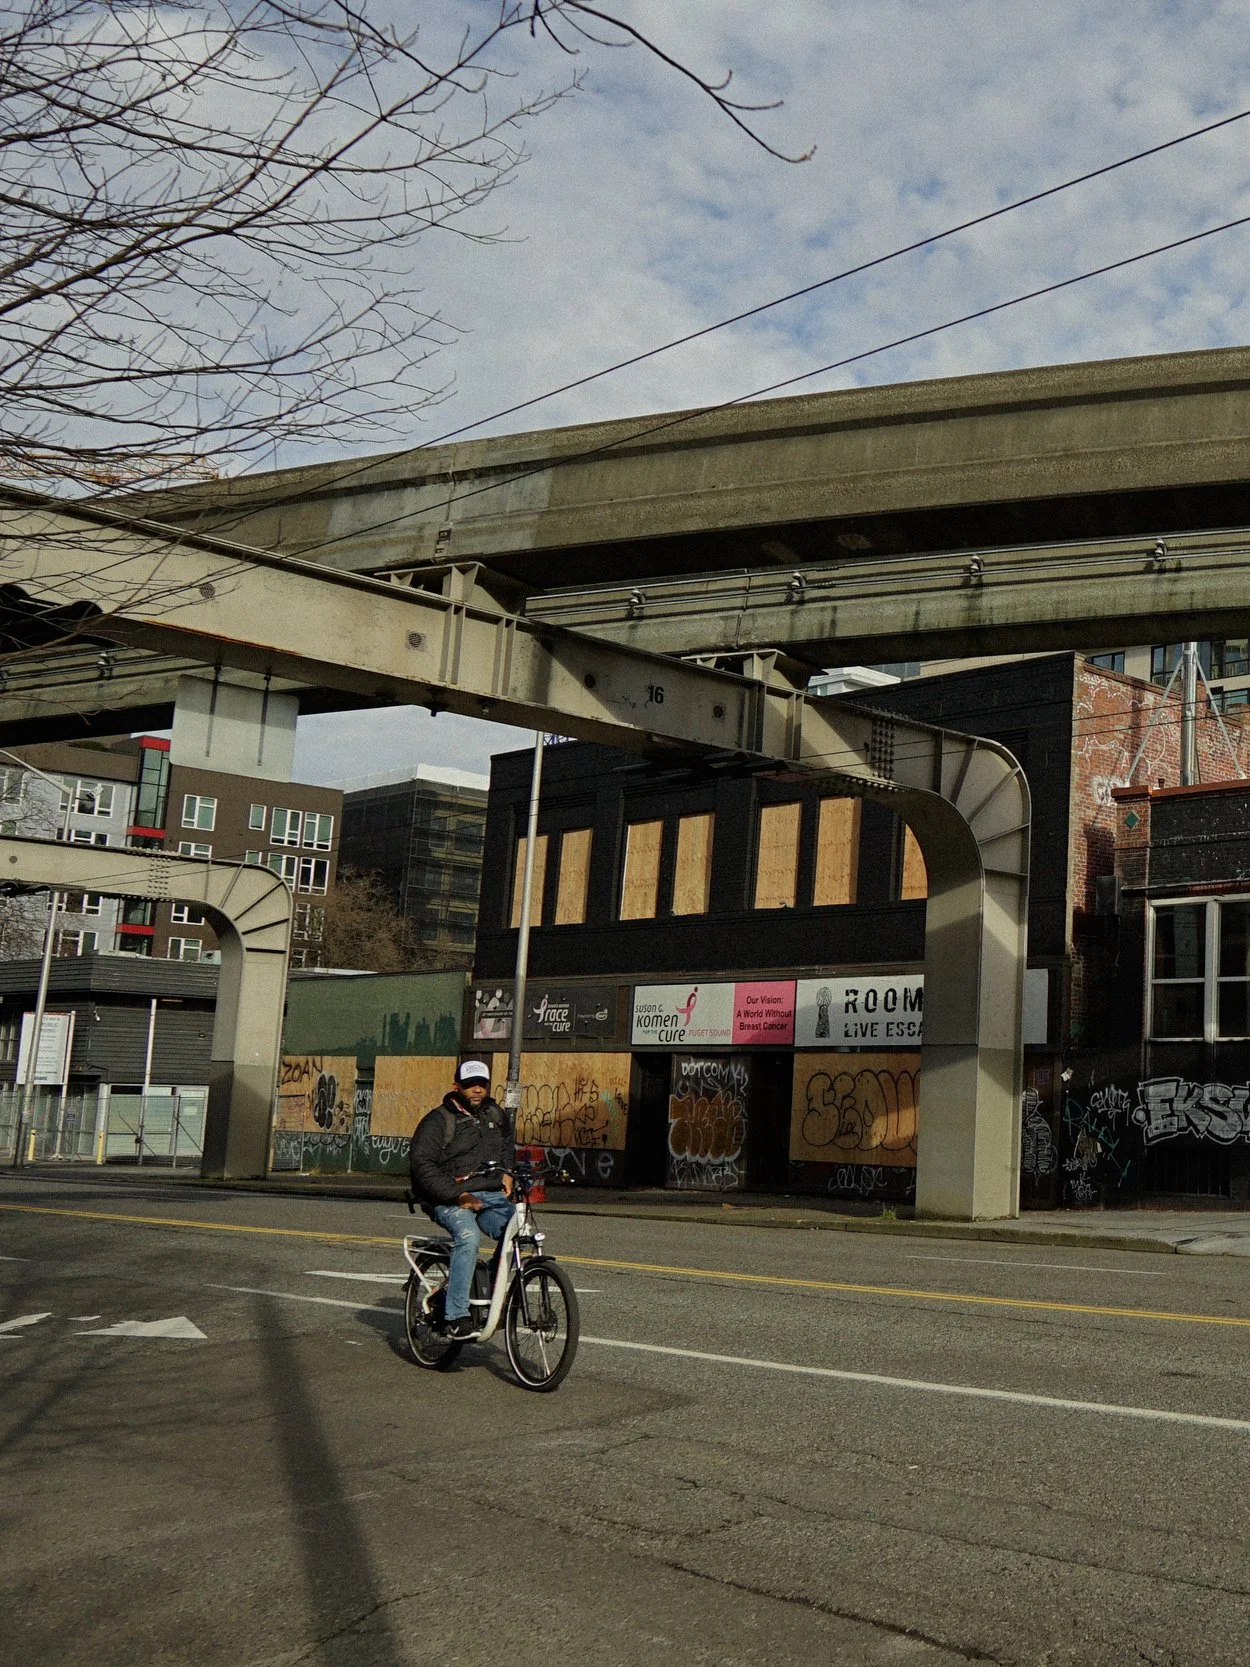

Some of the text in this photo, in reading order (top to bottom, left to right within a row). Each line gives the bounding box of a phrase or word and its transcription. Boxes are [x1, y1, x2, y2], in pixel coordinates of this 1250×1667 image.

[648, 685, 664, 704] 16
[746, 995, 784, 1004] Our Vision:
[845, 987, 923, 1013] ROOM
[545, 1009, 569, 1021] race
[737, 1009, 792, 1018] A World Without
[552, 1022, 570, 1032] cure
[739, 1022, 788, 1031] Breast Cancer
[844, 1022, 879, 1038] LIVE
[658, 1029, 686, 1042] cure
[688, 1029, 731, 1037] PUGET SOUND
